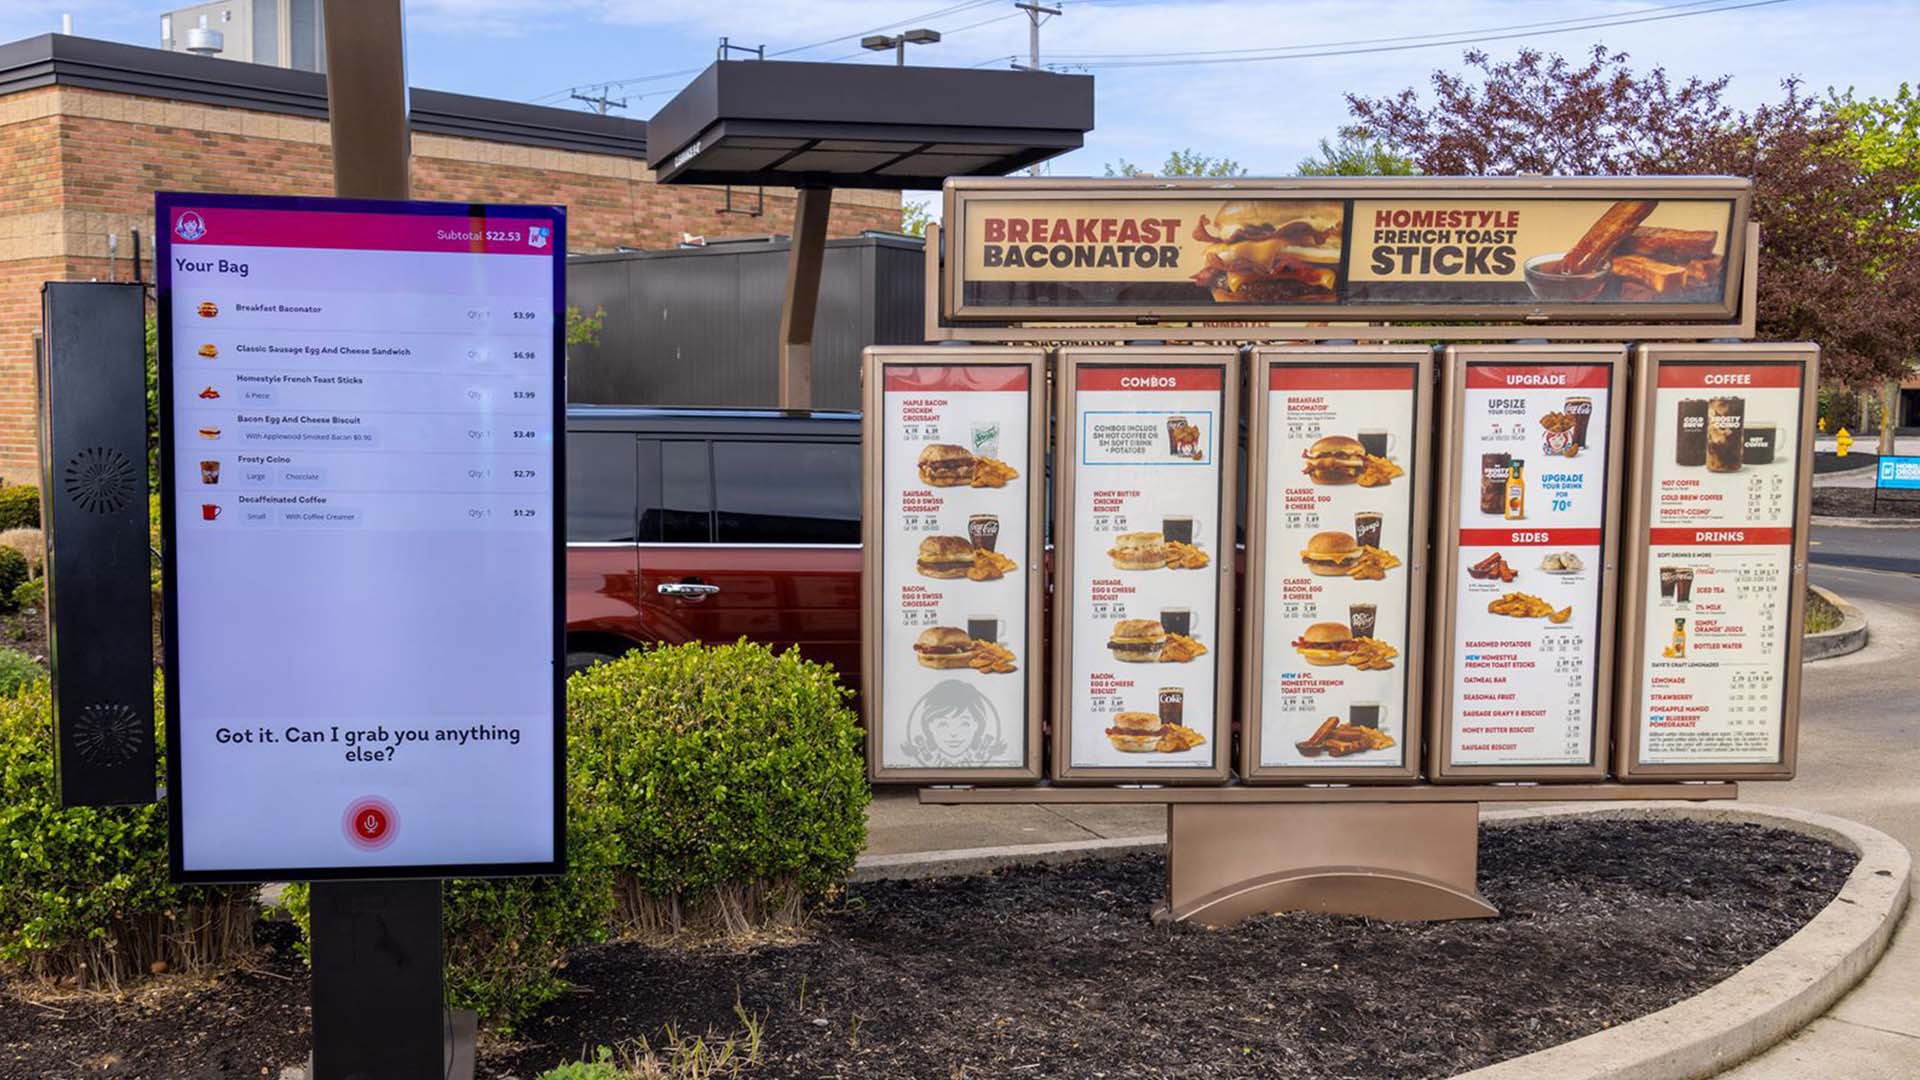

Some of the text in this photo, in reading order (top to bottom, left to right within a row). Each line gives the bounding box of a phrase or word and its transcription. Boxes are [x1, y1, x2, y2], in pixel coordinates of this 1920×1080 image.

[1374, 210, 1520, 229] HOMESTYLE
[984, 217, 1182, 244] BREAKFAST
[436, 230, 521, 242] Subtotal $22.53
[1374, 230, 1517, 245] FRENCH TOAST
[982, 245, 1181, 269] BACONATOR
[1371, 246, 1516, 275] STICKS
[176, 258, 249, 278] Your Bag
[236, 304, 322, 313] Breakfast Baconator
[513, 312, 536, 320] $3.99
[236, 344, 411, 355] Classic Sausage Egg And Cheese Sandwich
[236, 374, 363, 384] Homestyle French Toast Sticks
[1120, 377, 1176, 388] COMBOS
[1506, 375, 1566, 385] UPGRADE
[1704, 375, 1751, 384] COFFEE
[513, 392, 536, 400] $3.99
[1488, 399, 1526, 408] UPSIZE
[265, 415, 280, 424] Egg
[282, 415, 298, 424] And
[300, 415, 330, 424] Cheese
[332, 415, 361, 424] Biscuit
[513, 430, 536, 439] $3.49
[238, 456, 291, 464] Frosty Ccino
[513, 470, 536, 478] $2.79
[1542, 474, 1584, 482] UPGRADE
[238, 496, 327, 504] Decaffeinated Coffee
[513, 510, 536, 518] $1.29
[1512, 533, 1549, 542] SIDES
[1696, 532, 1744, 542] DRINKS
[216, 724, 520, 746] Got it. Can I grab you anything
[346, 746, 395, 762] else?
